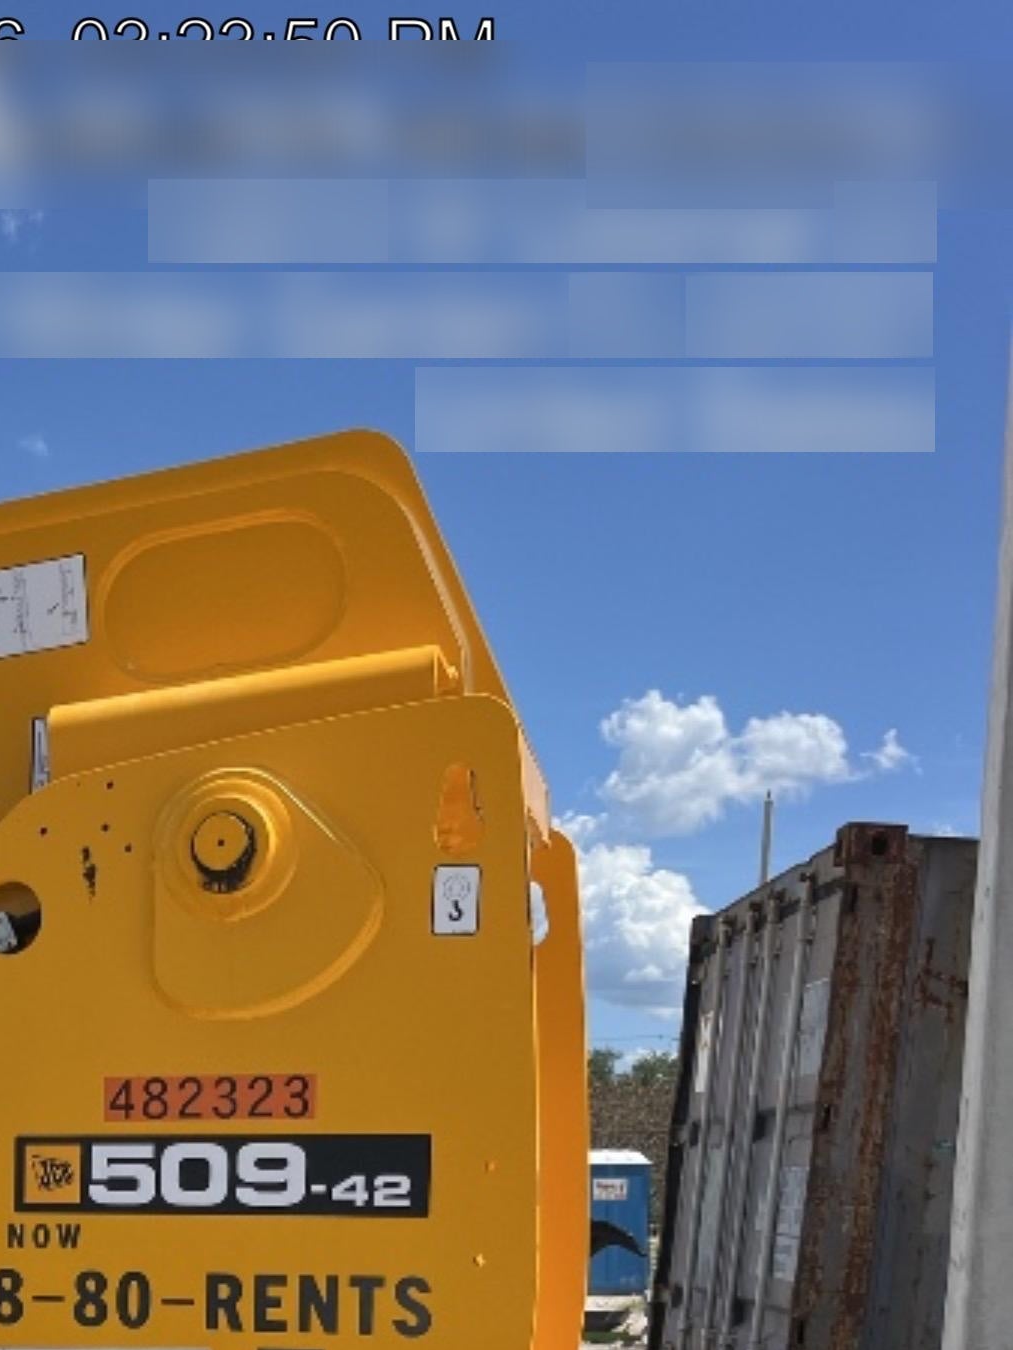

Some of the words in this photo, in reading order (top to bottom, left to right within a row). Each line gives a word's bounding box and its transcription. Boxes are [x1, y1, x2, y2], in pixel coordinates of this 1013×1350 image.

[109, 1075, 309, 1119] 482323
[89, 1142, 411, 1207] 509-42
[7, 1223, 81, 1248] NOW
